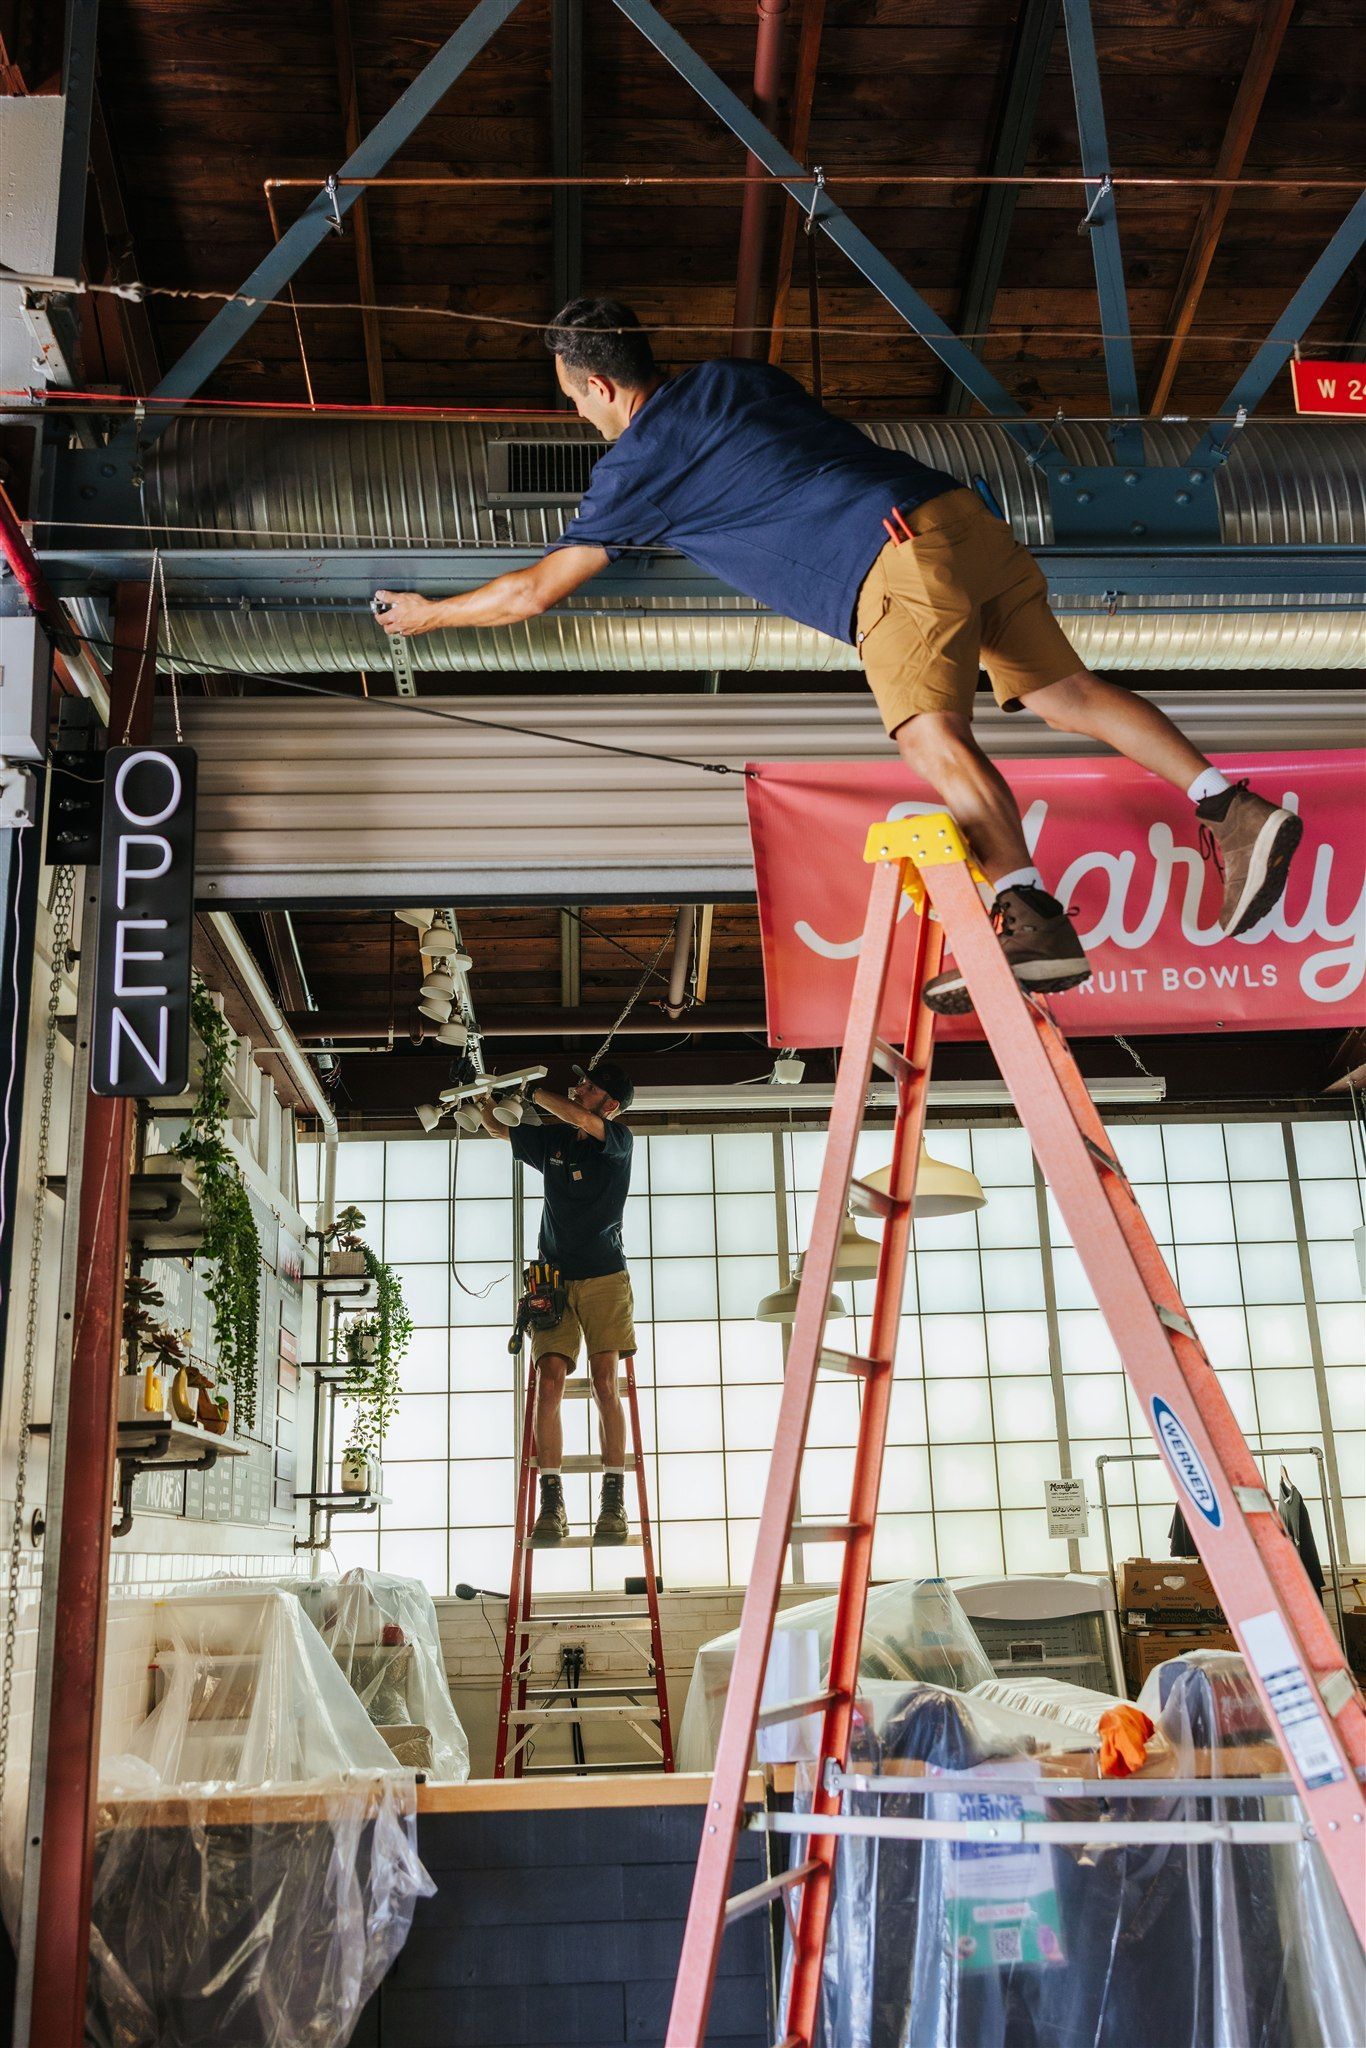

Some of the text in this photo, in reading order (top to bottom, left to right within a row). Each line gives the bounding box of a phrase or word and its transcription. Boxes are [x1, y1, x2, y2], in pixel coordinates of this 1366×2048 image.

[1317, 379, 1366, 400] W 2
[109, 750, 182, 1086] OPEN
[1060, 963, 1278, 996] RUIT BOWLS
[1164, 1421, 1209, 1501] WERNER
[958, 1801, 1026, 1822] HIRING
